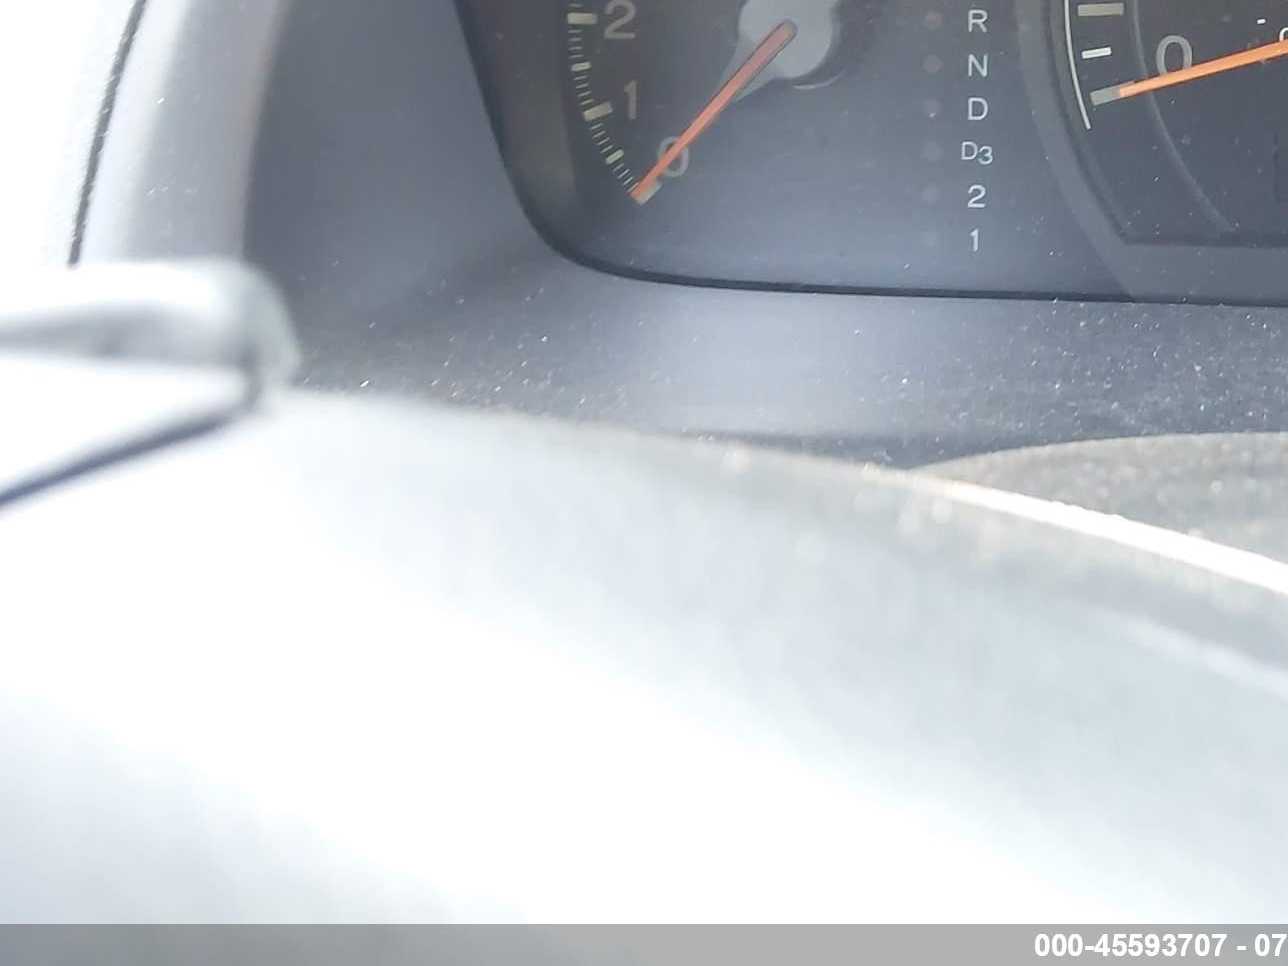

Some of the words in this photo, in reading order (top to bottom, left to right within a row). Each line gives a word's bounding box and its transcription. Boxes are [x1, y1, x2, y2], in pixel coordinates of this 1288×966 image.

[968, 10, 989, 33] R
[967, 54, 988, 77] N
[1155, 34, 1193, 76] 0
[623, 80, 638, 120] 1
[967, 98, 989, 121] D
[657, 137, 690, 178] 0
[960, 141, 994, 165] D3
[967, 184, 987, 208] 2
[970, 229, 980, 251] 1
